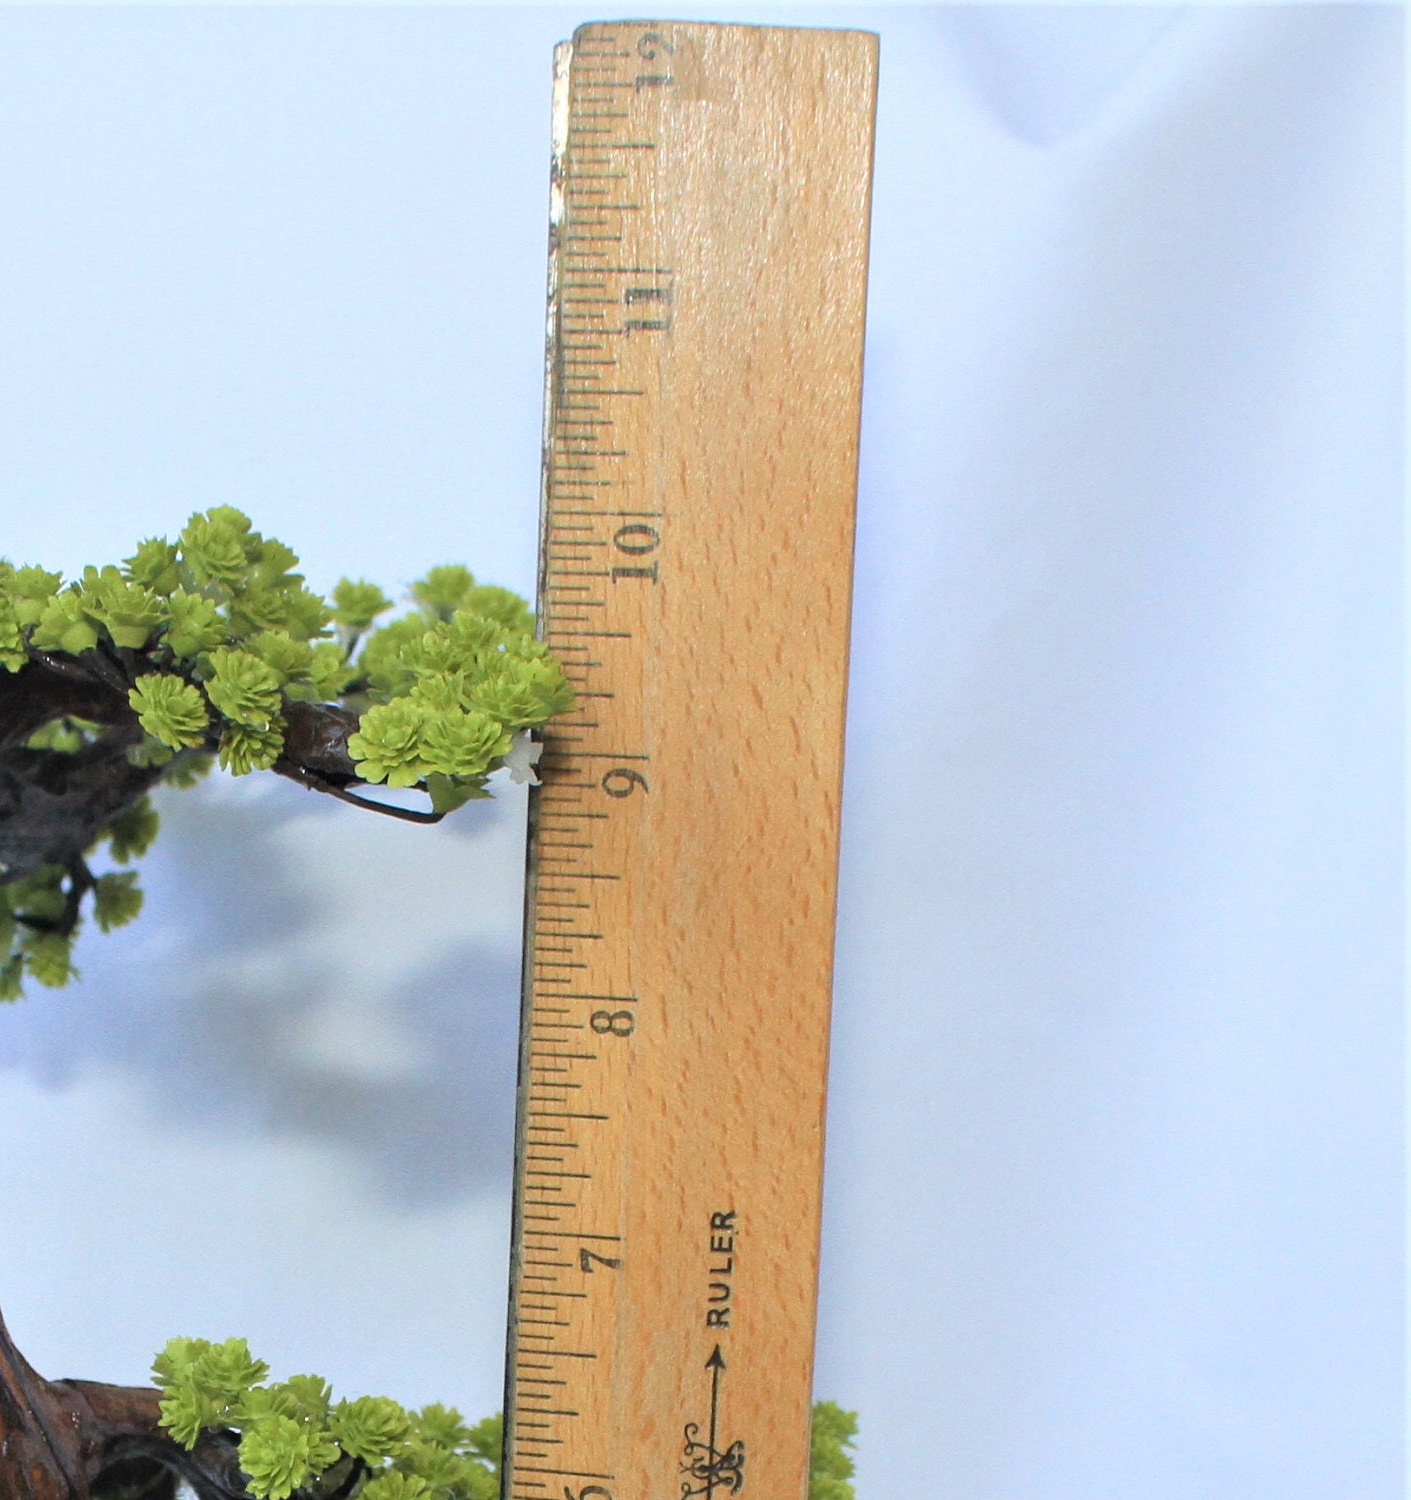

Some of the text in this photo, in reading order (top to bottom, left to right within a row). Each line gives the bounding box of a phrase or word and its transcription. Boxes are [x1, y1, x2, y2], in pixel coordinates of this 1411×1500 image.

[635, 32, 675, 93] 12
[623, 278, 674, 337] 11
[610, 523, 661, 586] 10
[600, 767, 650, 799] 9
[589, 1009, 635, 1038] 8
[579, 1247, 622, 1275] 7
[706, 1208, 737, 1329] RULER
